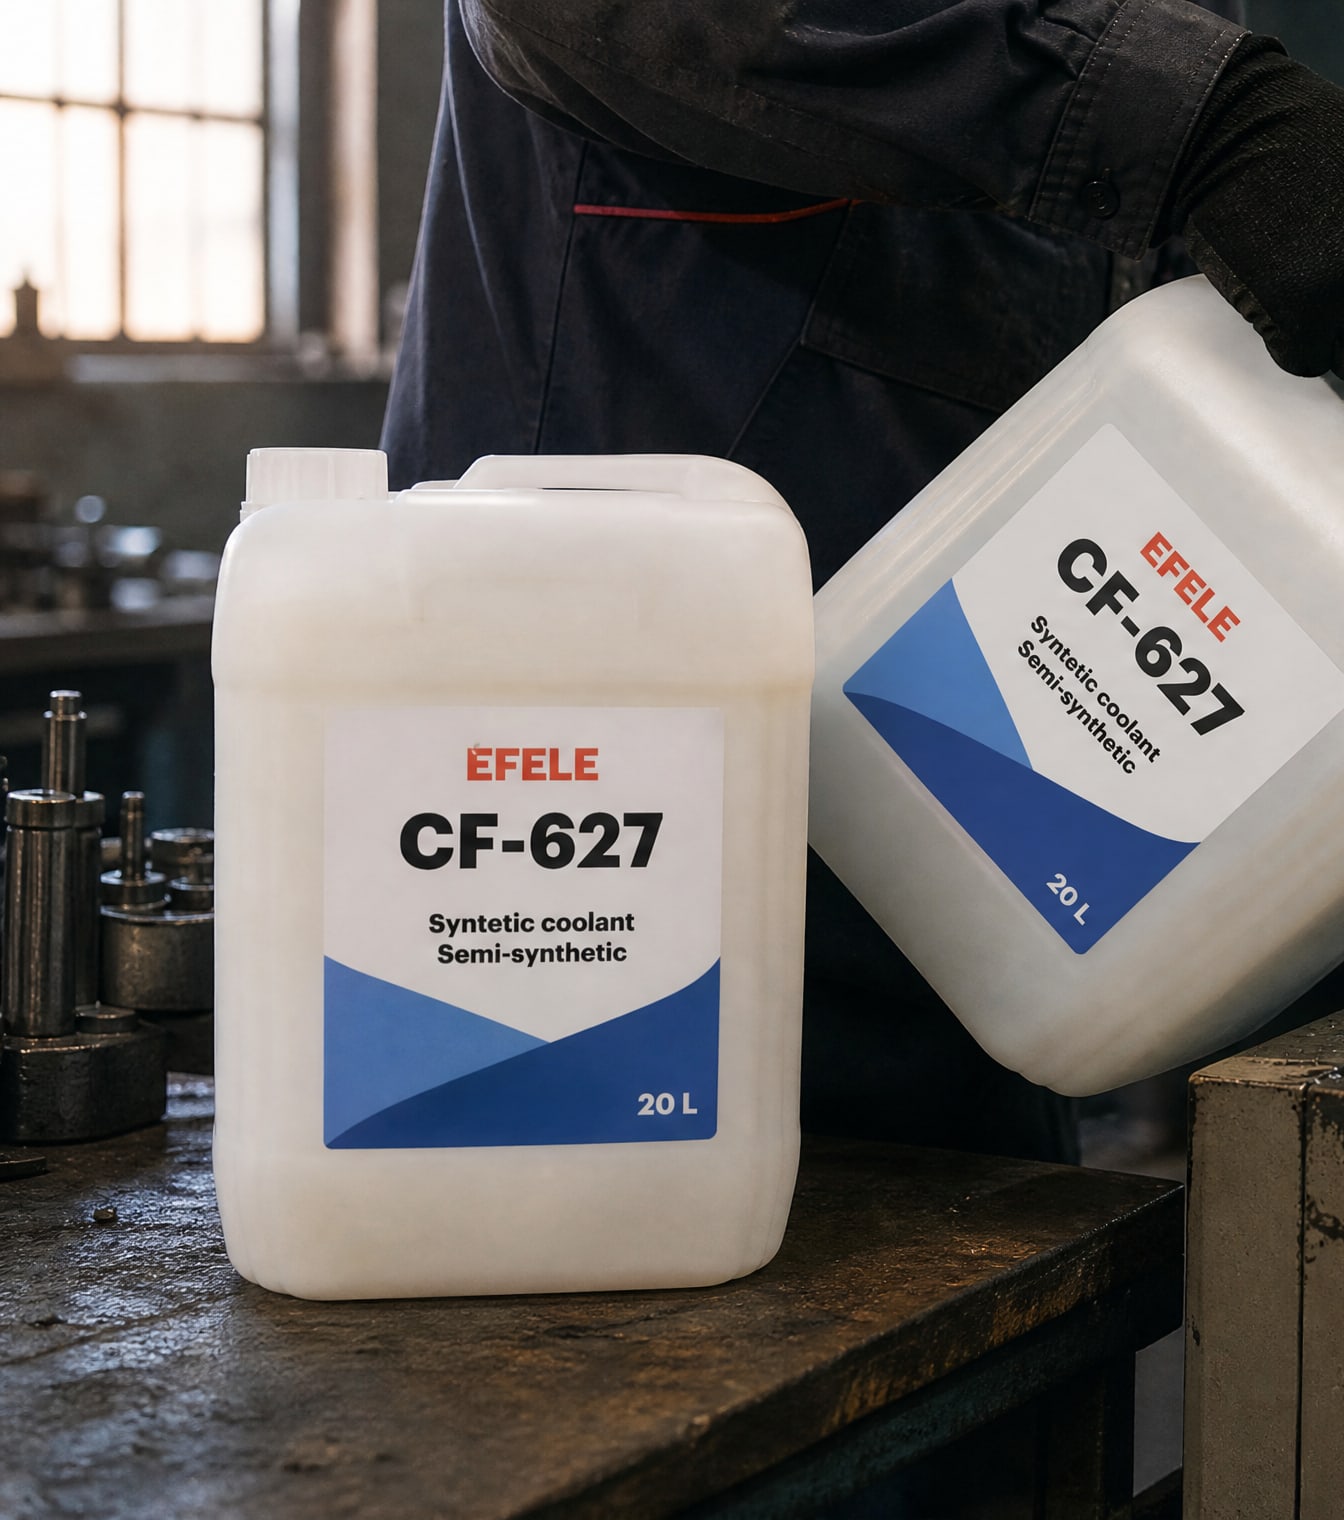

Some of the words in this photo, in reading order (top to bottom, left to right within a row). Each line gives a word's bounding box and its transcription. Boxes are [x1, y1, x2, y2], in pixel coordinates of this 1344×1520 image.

[1140, 531, 1241, 643] EFELE
[1057, 538, 1246, 736] CF-627
[1017, 639, 1136, 774] Semi-synthetic
[1030, 615, 1098, 693] Syntetic
[1096, 691, 1161, 764] coolant
[466, 747, 600, 782] EFELE
[399, 811, 664, 871] CF-627
[428, 911, 535, 938] Syntetic
[540, 911, 635, 933] coolant
[1046, 873, 1078, 906] 20
[1073, 902, 1090, 926] L
[437, 941, 628, 968] Semi-synthetic
[637, 1092, 675, 1116] 20
[682, 1092, 698, 1114] L
